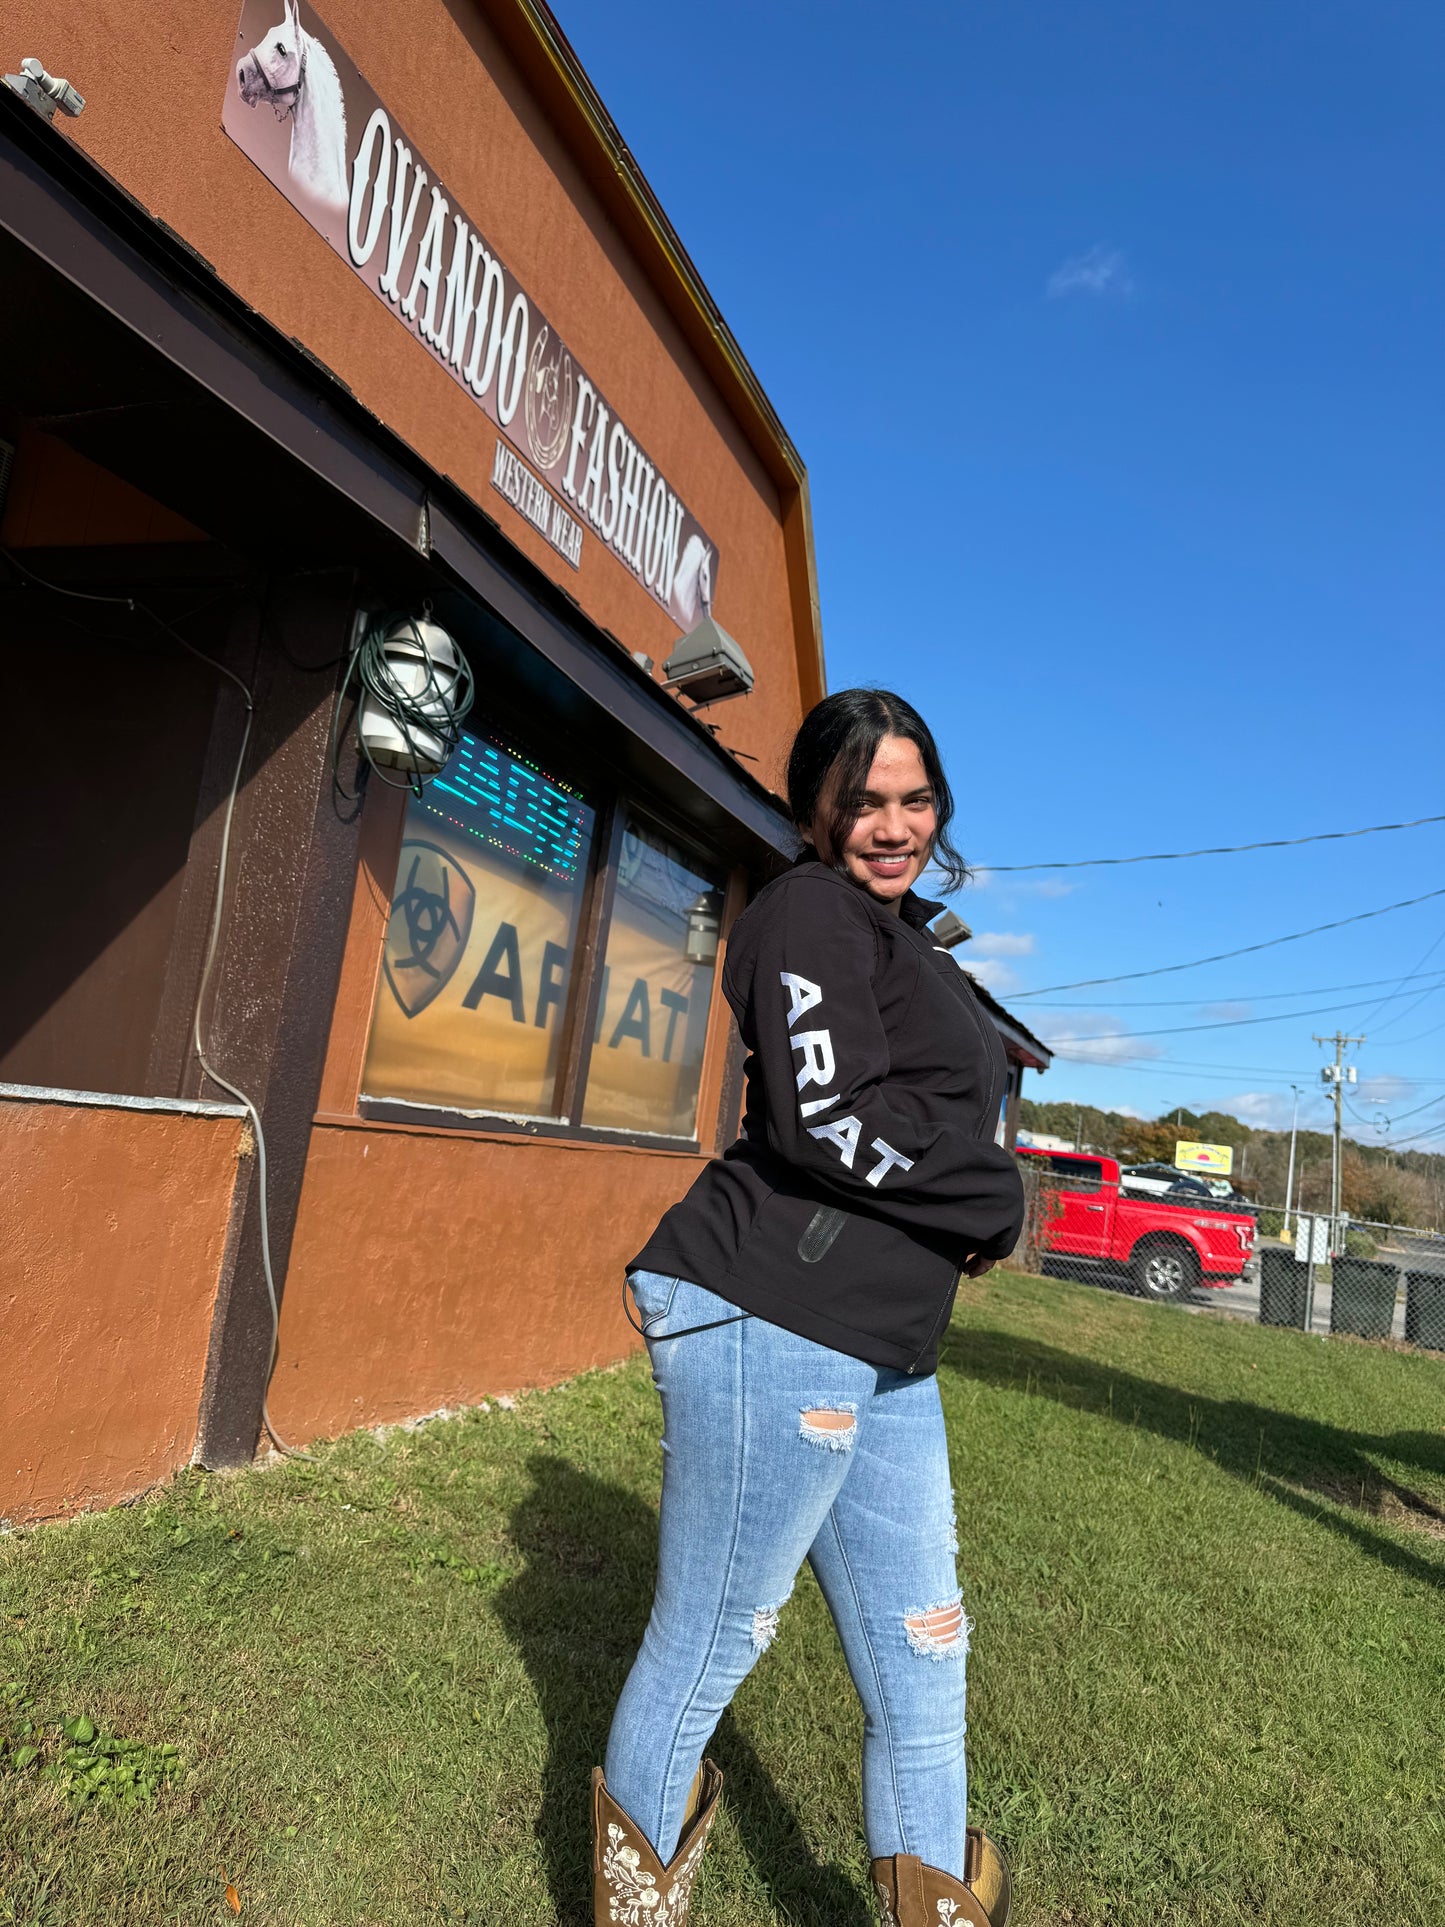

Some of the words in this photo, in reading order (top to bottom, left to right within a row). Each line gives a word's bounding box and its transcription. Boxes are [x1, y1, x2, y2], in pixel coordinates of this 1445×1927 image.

[348, 108, 528, 426] OVANDO
[493, 438, 552, 537] WESTERN
[551, 506, 583, 568] WEAR
[562, 374, 684, 603] FASHION
[780, 972, 915, 1187] ARIAT
